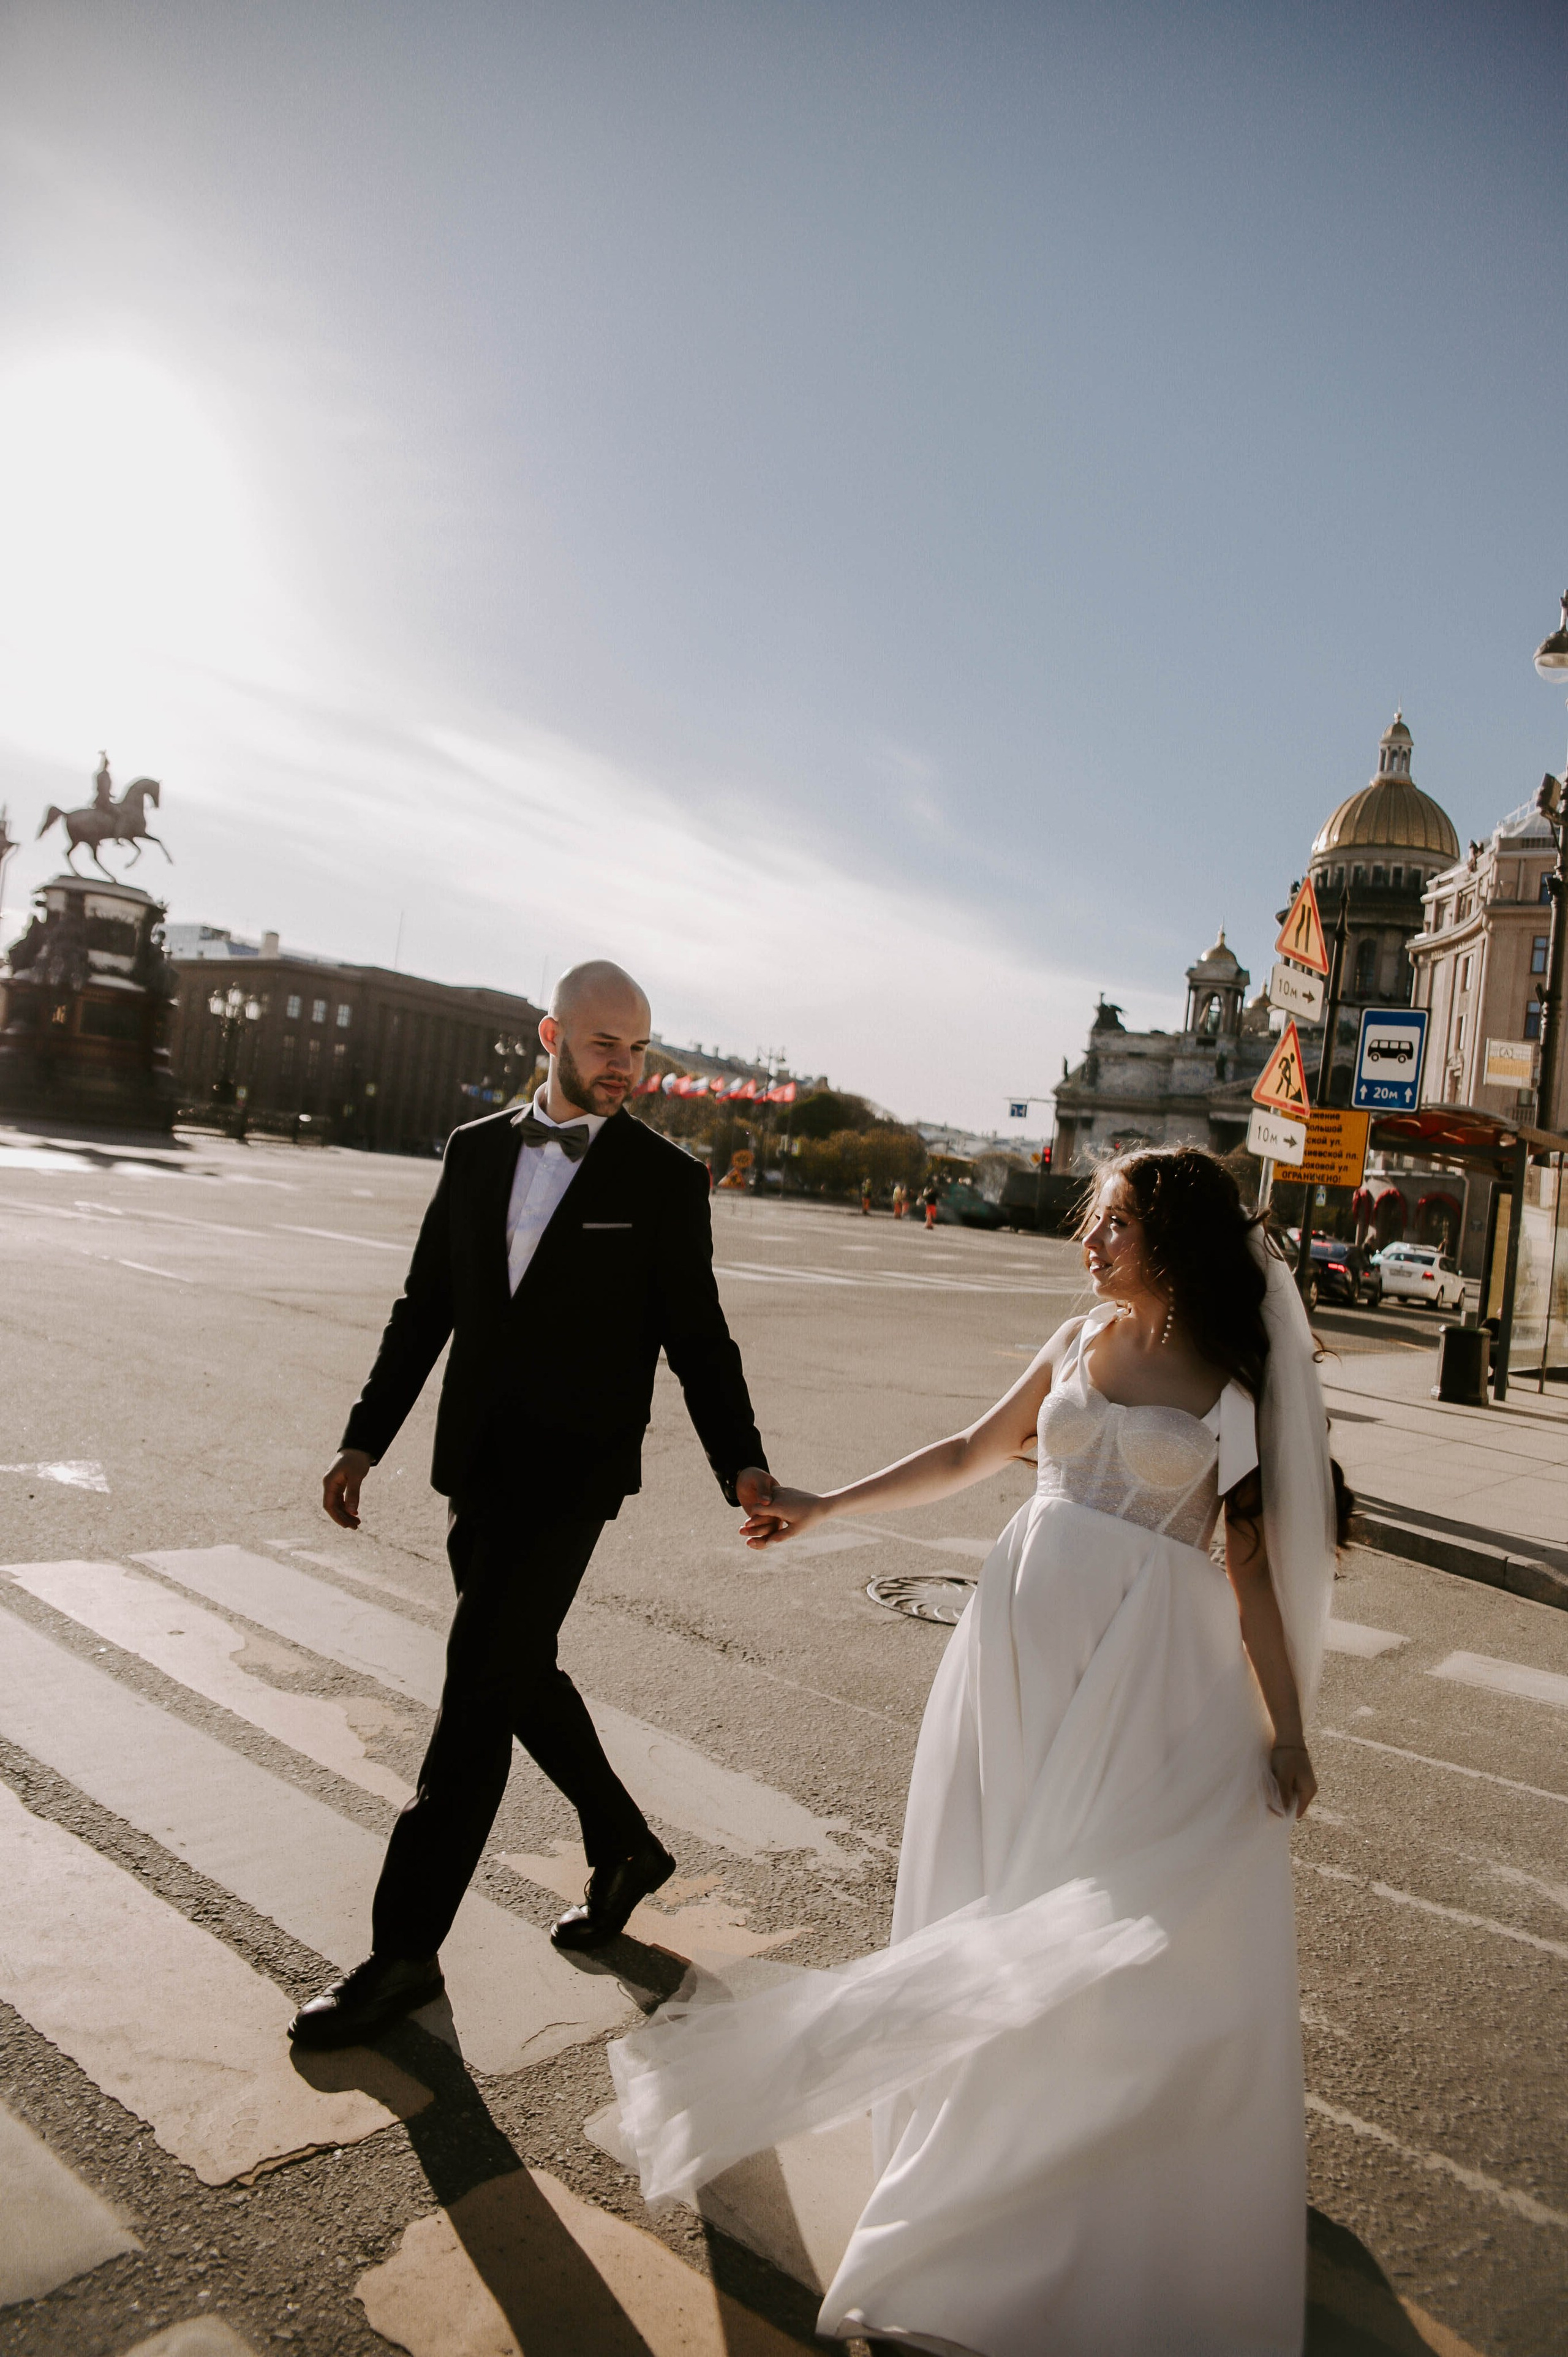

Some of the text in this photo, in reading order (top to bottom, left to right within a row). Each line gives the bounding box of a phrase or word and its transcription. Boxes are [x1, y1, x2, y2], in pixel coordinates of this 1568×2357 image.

[1278, 979, 1297, 998] 10м
[1373, 1087, 1398, 1099] 20м
[1258, 1125, 1277, 1145] 10м
[1305, 1136, 1327, 1144] ской
[1282, 1171, 1341, 1183] ОГРАНИЧЕНО!
